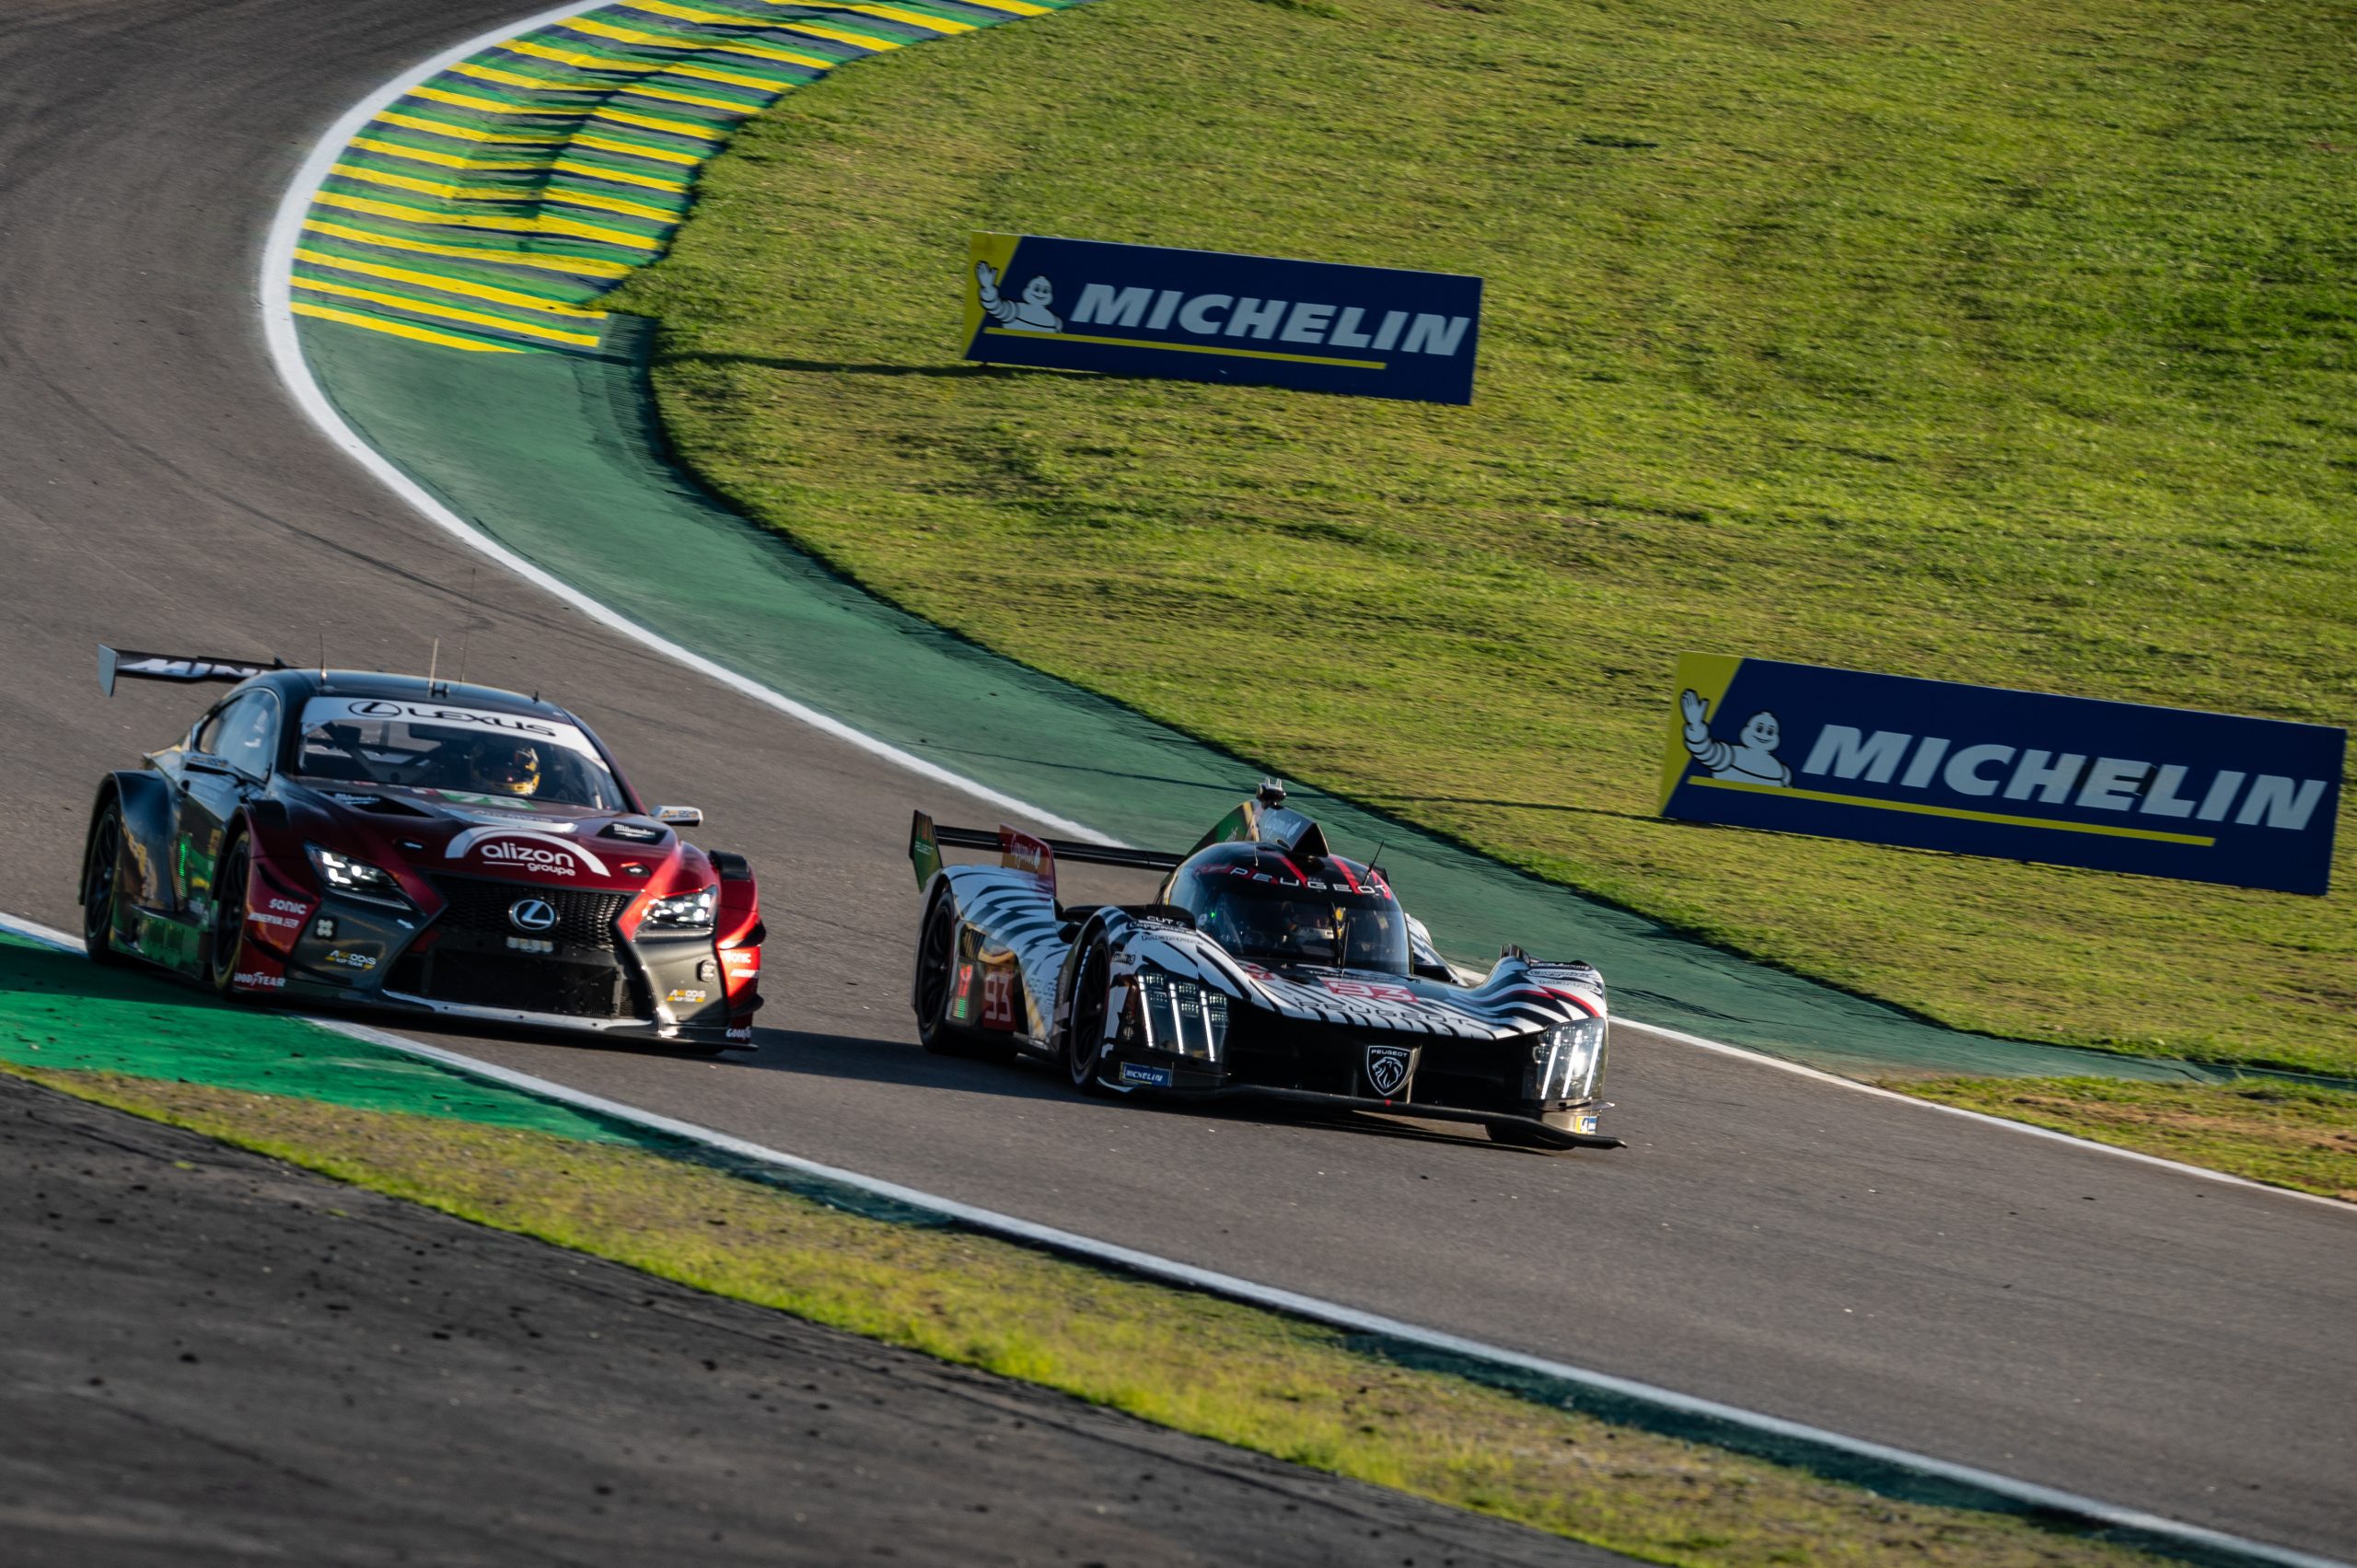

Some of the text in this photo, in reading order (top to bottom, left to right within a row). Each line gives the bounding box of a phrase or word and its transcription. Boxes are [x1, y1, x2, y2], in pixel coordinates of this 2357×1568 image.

[1070, 284, 1470, 355] MICHELIN
[408, 707, 555, 737] LEXUS
[1802, 725, 2327, 830] MICHELIN
[481, 842, 575, 867] alizon
[527, 863, 576, 877] groupe
[1230, 866, 1387, 894] PEUGEOT
[984, 974, 1013, 1022] 93
[1328, 982, 1414, 1002] 93
[1298, 1001, 1469, 1025] PEUGEOT
[1371, 1050, 1408, 1058] PEUGEOT
[1126, 1070, 1164, 1082] MICHELIN
